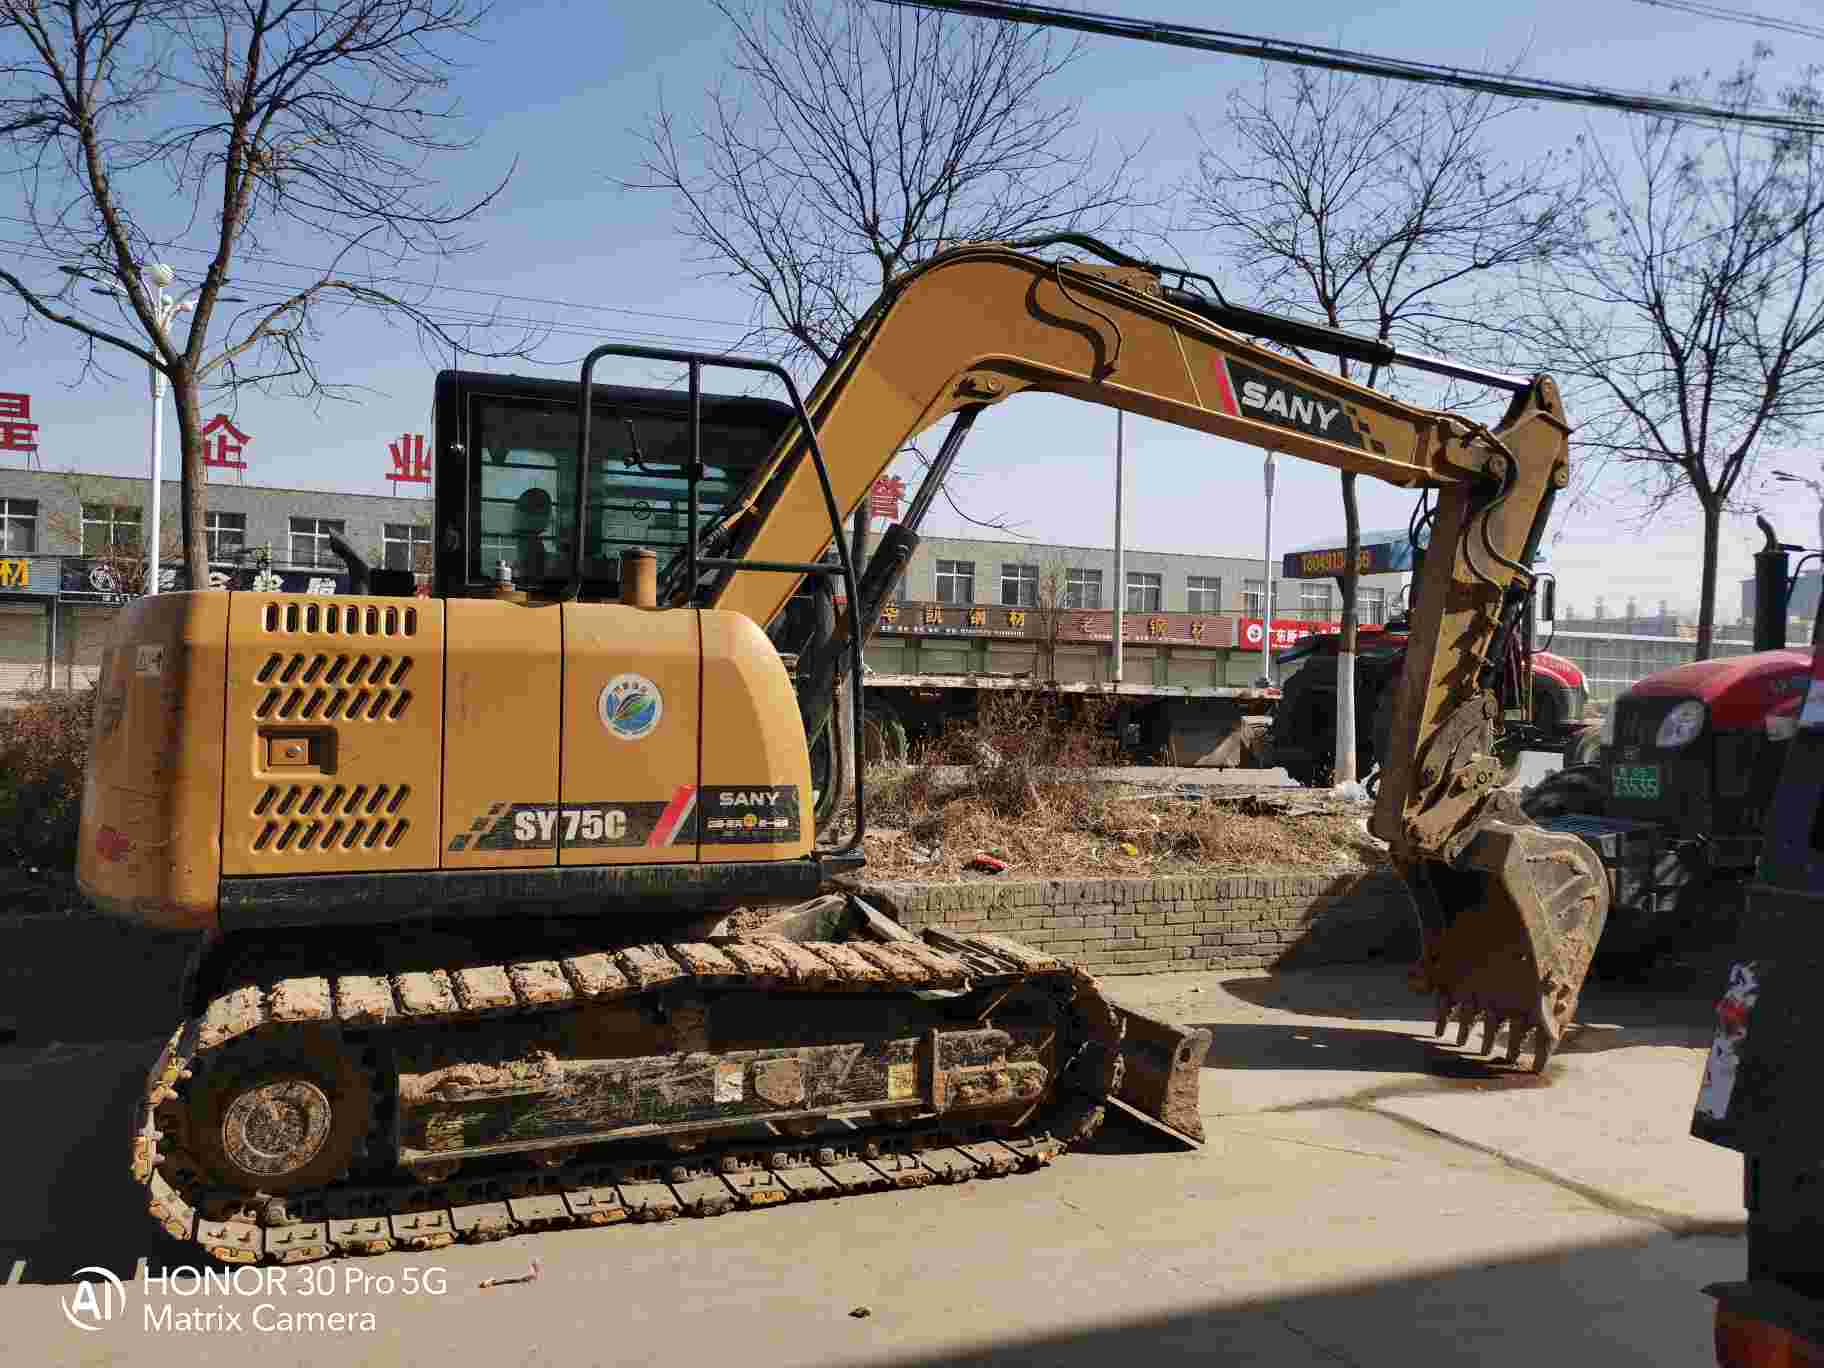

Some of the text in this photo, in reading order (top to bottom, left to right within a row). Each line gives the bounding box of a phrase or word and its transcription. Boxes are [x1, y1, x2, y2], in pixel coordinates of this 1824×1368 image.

[1241, 380, 1340, 431] SANY
[203, 414, 253, 470] 企
[385, 433, 432, 482] 业
[719, 792, 780, 807] SANY
[513, 809, 627, 842] SY75C
